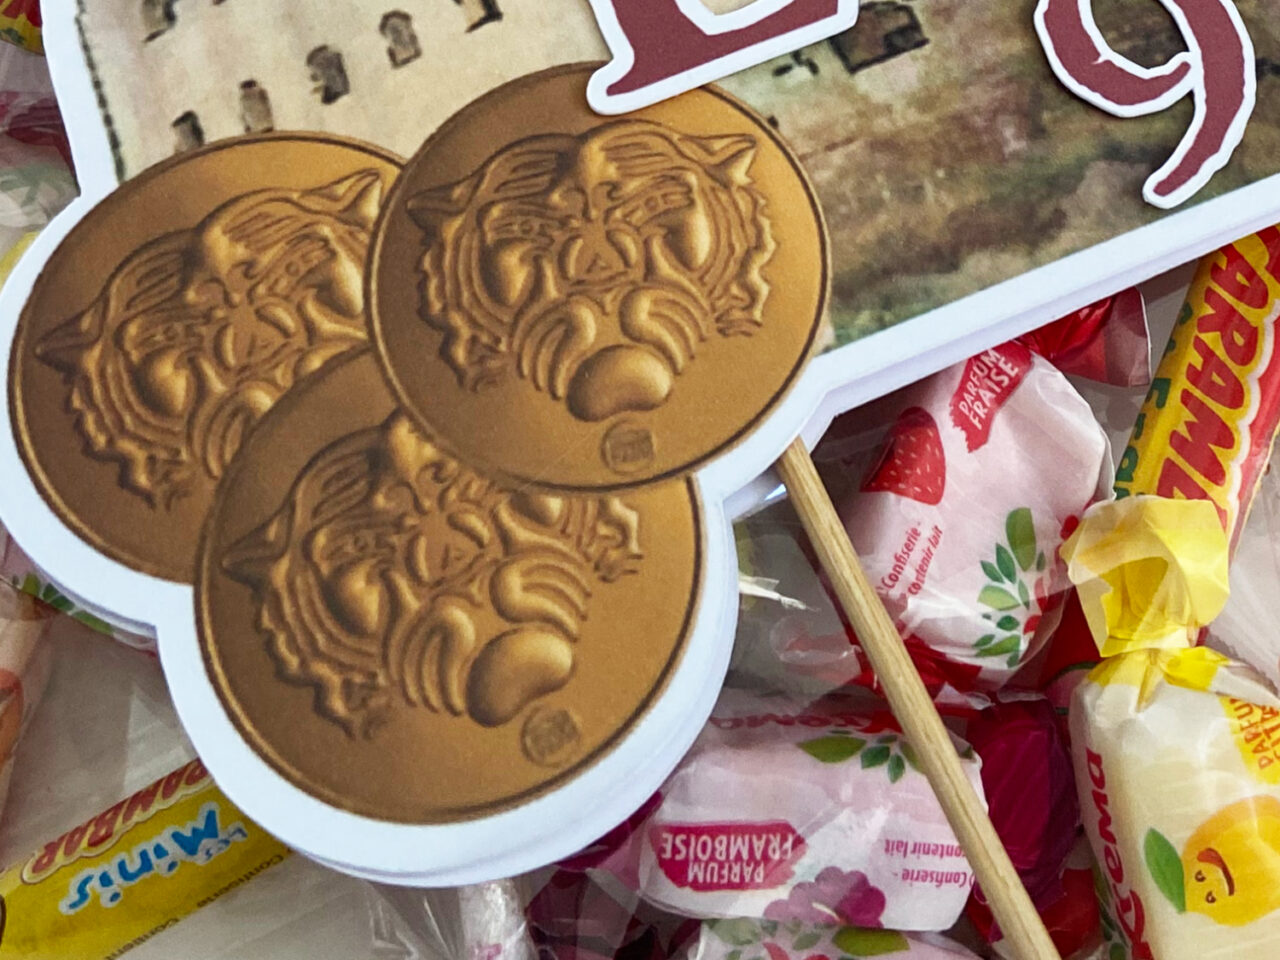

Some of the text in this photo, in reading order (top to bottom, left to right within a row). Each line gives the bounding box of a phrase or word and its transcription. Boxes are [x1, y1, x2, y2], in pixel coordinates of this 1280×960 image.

[957, 346, 1003, 416] PARFUM
[970, 356, 1020, 430] FRAISE
[1232, 698, 1277, 770] PARFU
[66, 807, 230, 913] Minis
[662, 830, 795, 862] FRAMBOISE
[884, 838, 907, 858] lait
[687, 859, 765, 886] PARFUM
[900, 866, 968, 889] Confiserie
